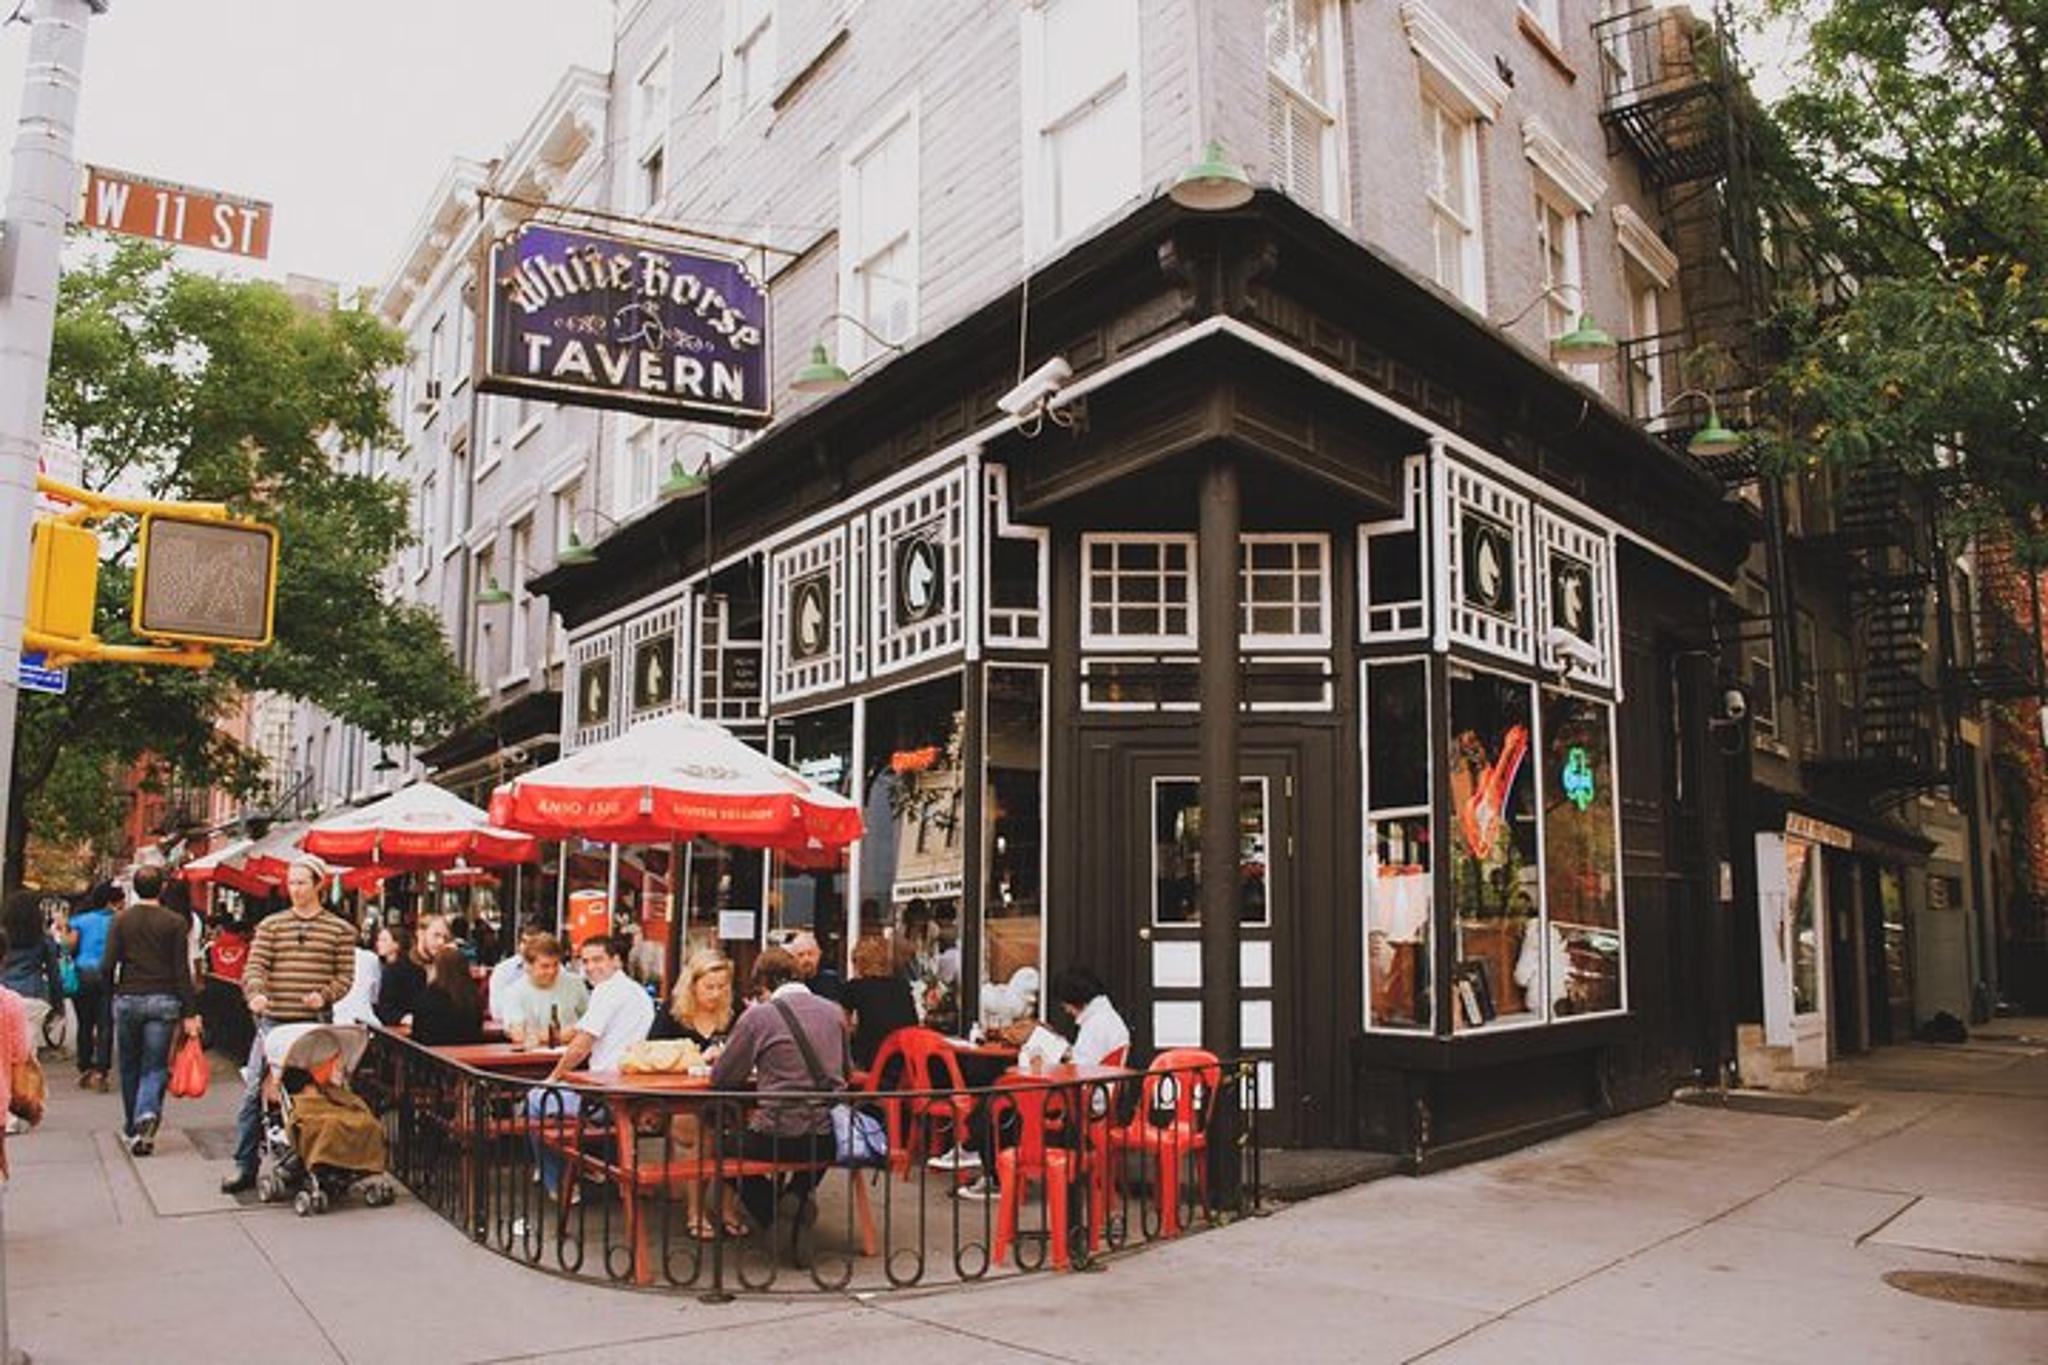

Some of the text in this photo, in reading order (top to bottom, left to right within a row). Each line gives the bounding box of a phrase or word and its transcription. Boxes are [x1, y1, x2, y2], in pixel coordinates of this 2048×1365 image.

[96, 178, 259, 254] W 11 ST
[502, 244, 762, 350] White Horse
[521, 331, 745, 402] TAVERN
